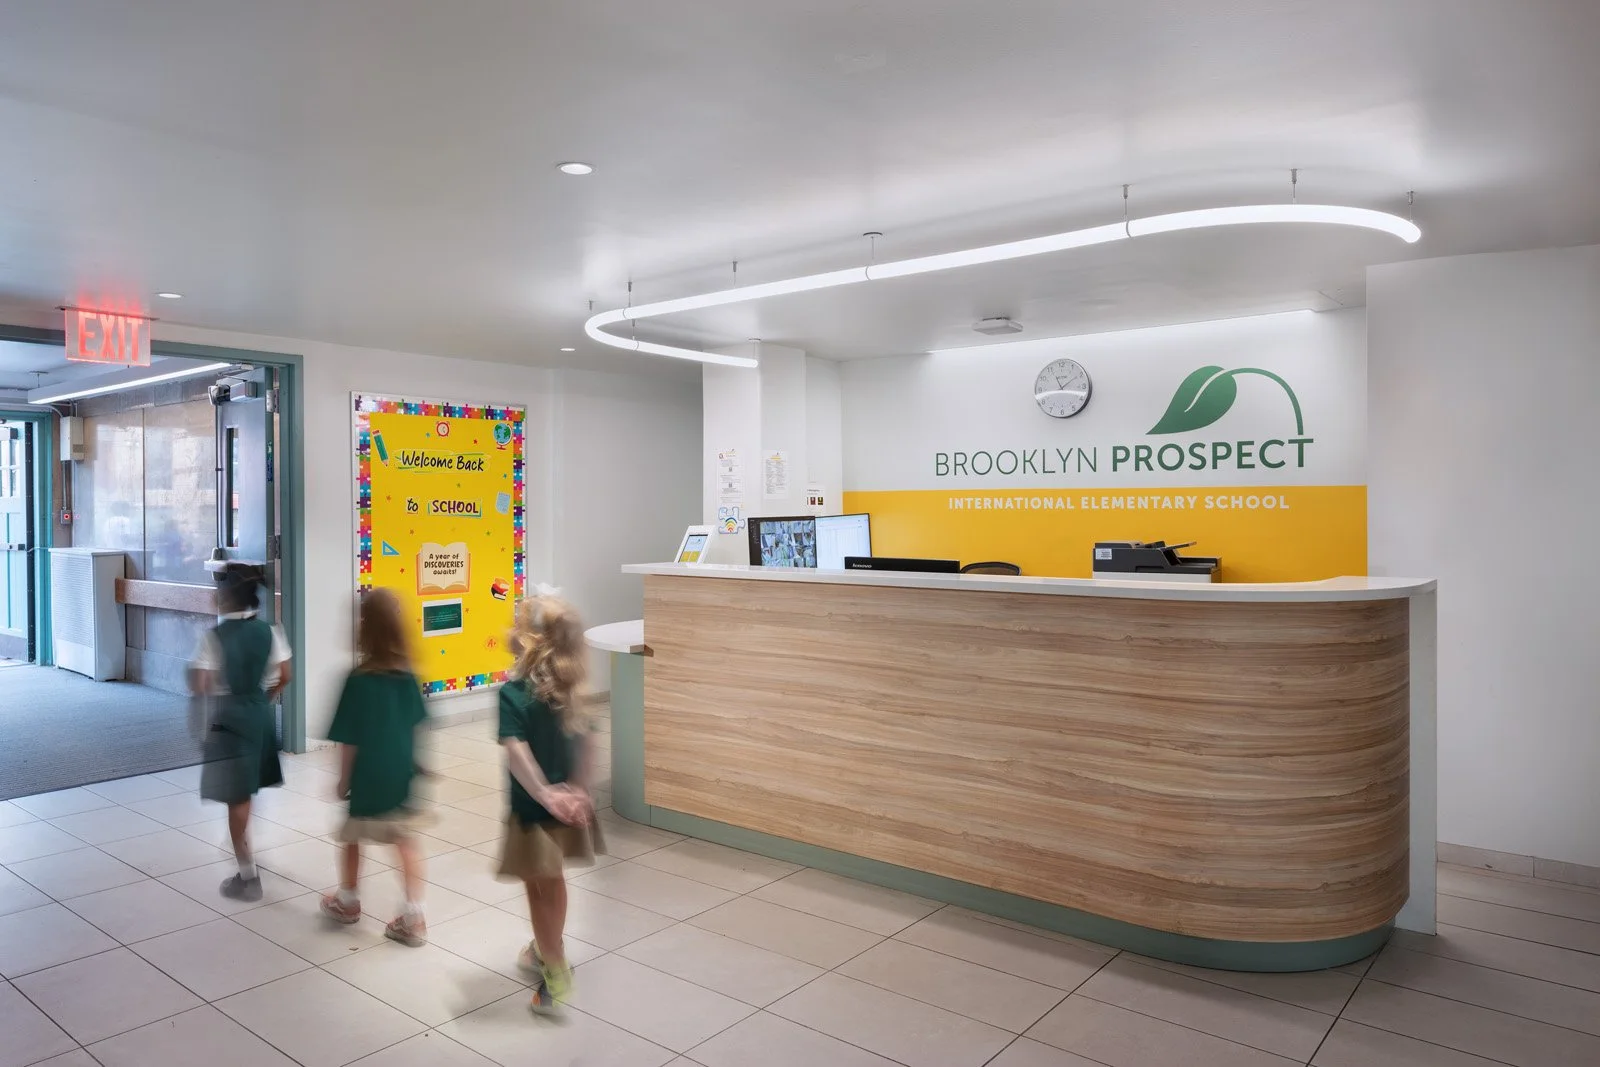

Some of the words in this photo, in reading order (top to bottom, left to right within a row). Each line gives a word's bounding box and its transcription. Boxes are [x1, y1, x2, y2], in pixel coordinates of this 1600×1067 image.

[78, 311, 143, 362] EXIT
[401, 450, 453, 469] Welcome
[456, 455, 484, 471] Back
[935, 446, 1097, 476] BROOKLYN
[1112, 438, 1314, 472] PROSPECT
[407, 498, 419, 512] to
[432, 500, 479, 514] SCHOOL
[948, 497, 1075, 510] INTERNATIONAL
[1081, 495, 1198, 509] ELEMENTARY
[1204, 495, 1290, 509] SCHOOL
[424, 560, 464, 568] DISCOVERIES
